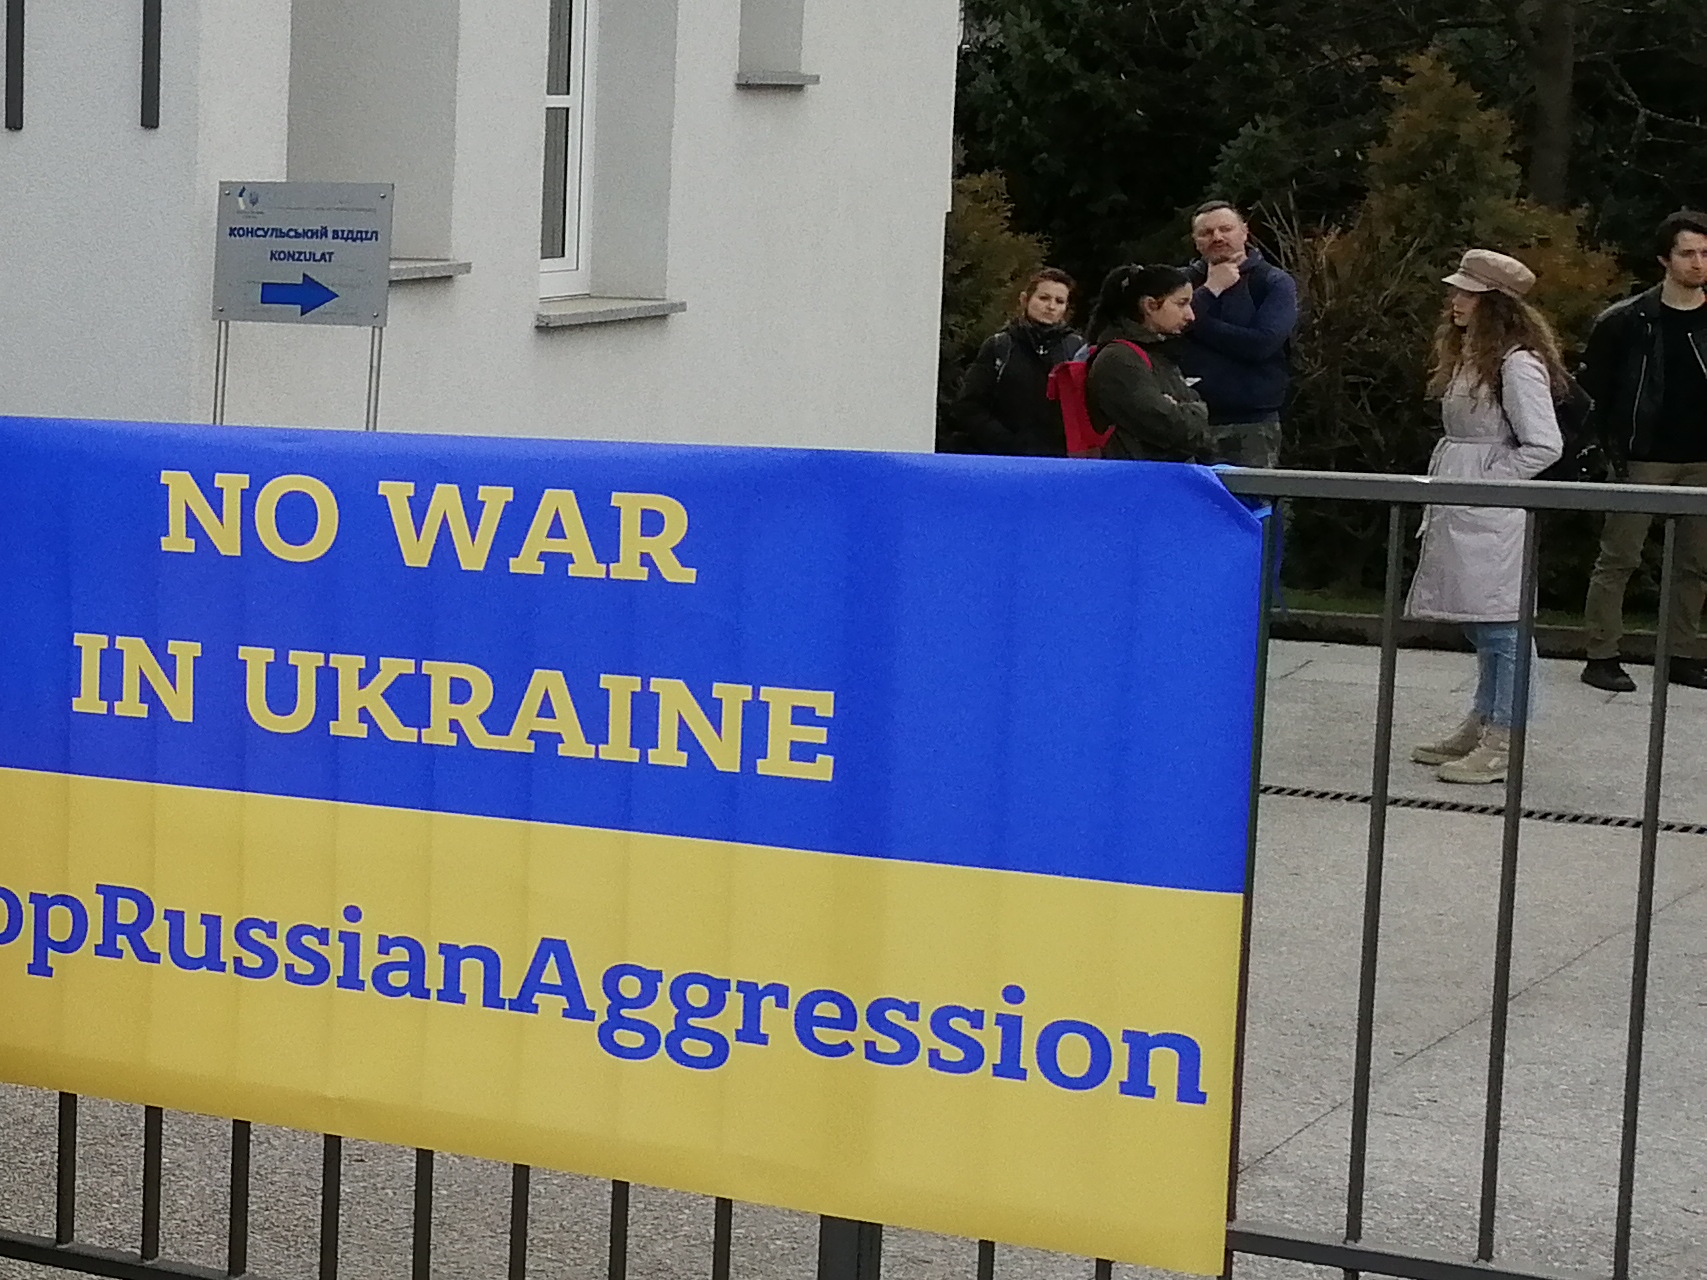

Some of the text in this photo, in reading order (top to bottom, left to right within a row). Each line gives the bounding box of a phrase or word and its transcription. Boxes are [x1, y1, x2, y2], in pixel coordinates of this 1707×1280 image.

[228, 226, 379, 242] КОНСУЛЬСЬКИЙ ВІДДІЛ
[269, 250, 335, 263] KONZULAT
[160, 471, 697, 584] NO WAR
[72, 633, 835, 782] IN UKRAINE
